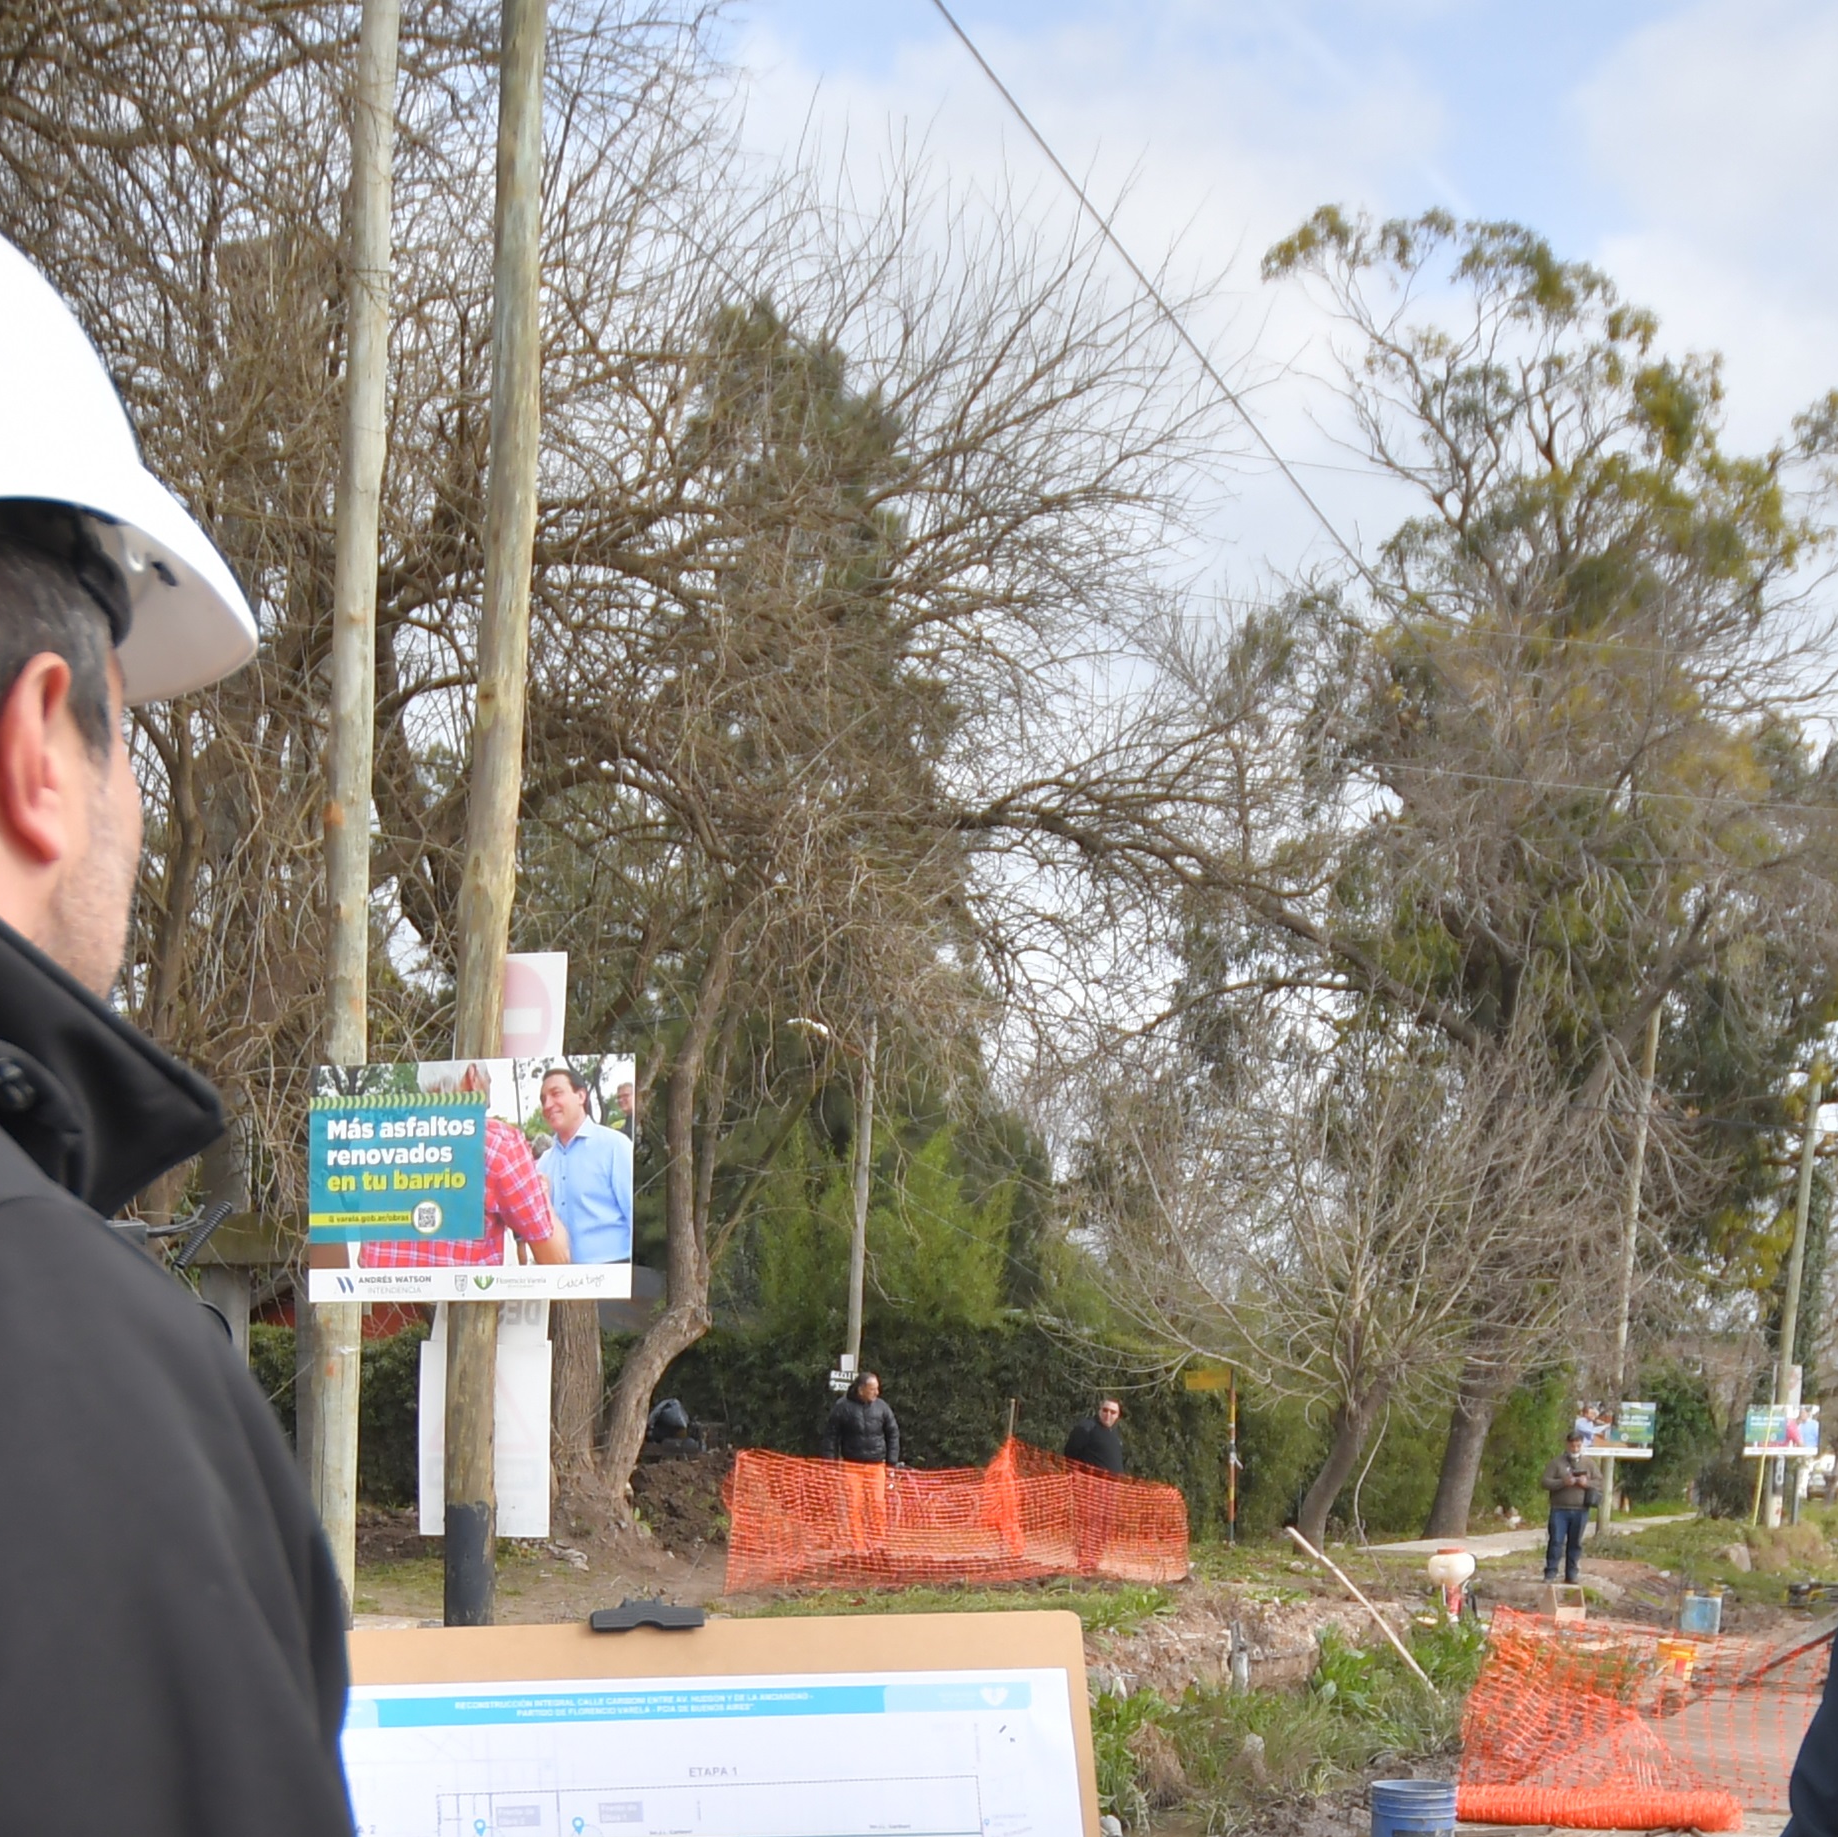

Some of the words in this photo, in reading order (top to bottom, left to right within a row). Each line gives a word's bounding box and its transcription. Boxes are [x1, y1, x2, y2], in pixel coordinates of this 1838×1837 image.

[327, 1118, 374, 1140] Más
[379, 1116, 476, 1139] asfaltos
[327, 1143, 453, 1166] renovados
[327, 1174, 356, 1192] en
[363, 1171, 388, 1191] tu
[393, 1168, 466, 1190] barrio
[358, 1275, 392, 1284] ANDRÉS
[395, 1275, 432, 1283] WATSON
[368, 1286, 422, 1295] INTENDENCIA
[689, 1767, 727, 1778] ETAPA
